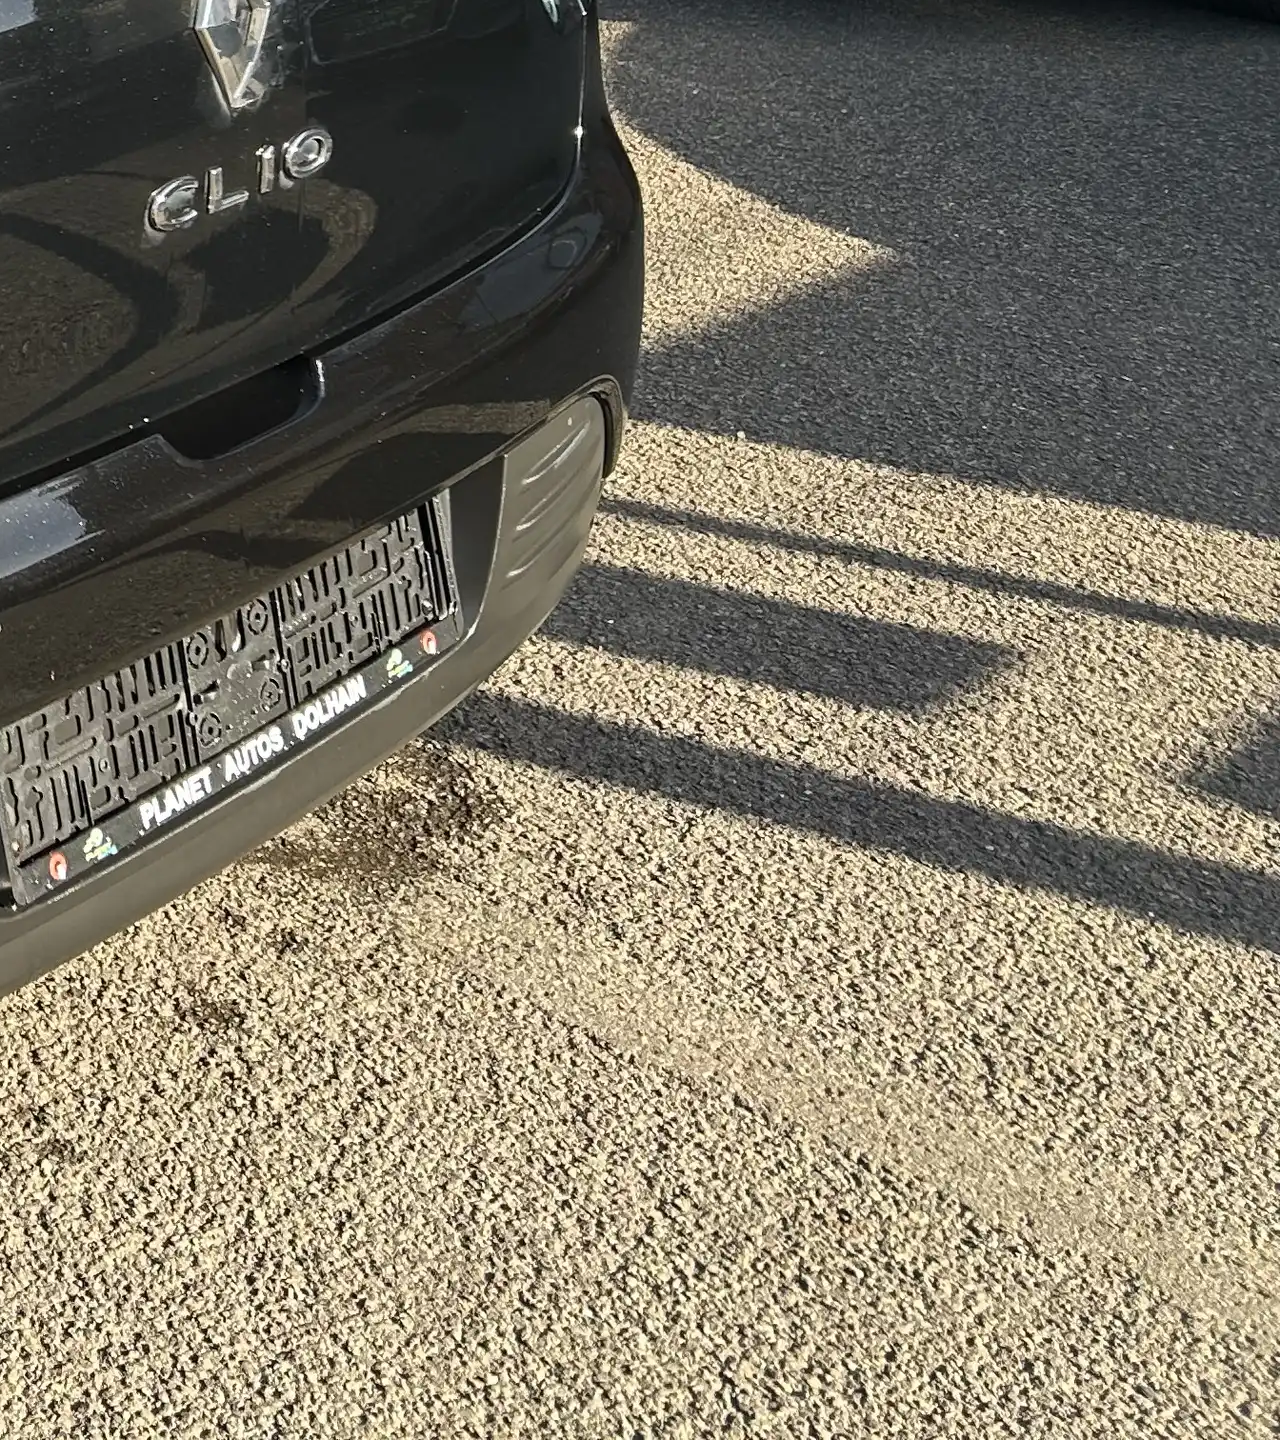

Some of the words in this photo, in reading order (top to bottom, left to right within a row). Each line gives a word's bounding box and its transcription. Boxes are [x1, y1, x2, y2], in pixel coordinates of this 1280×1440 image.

[144, 126, 333, 231] CLIO
[139, 767, 212, 831] PLANET
[224, 725, 284, 783] AUTOS
[291, 673, 368, 740] DOLHAIN
